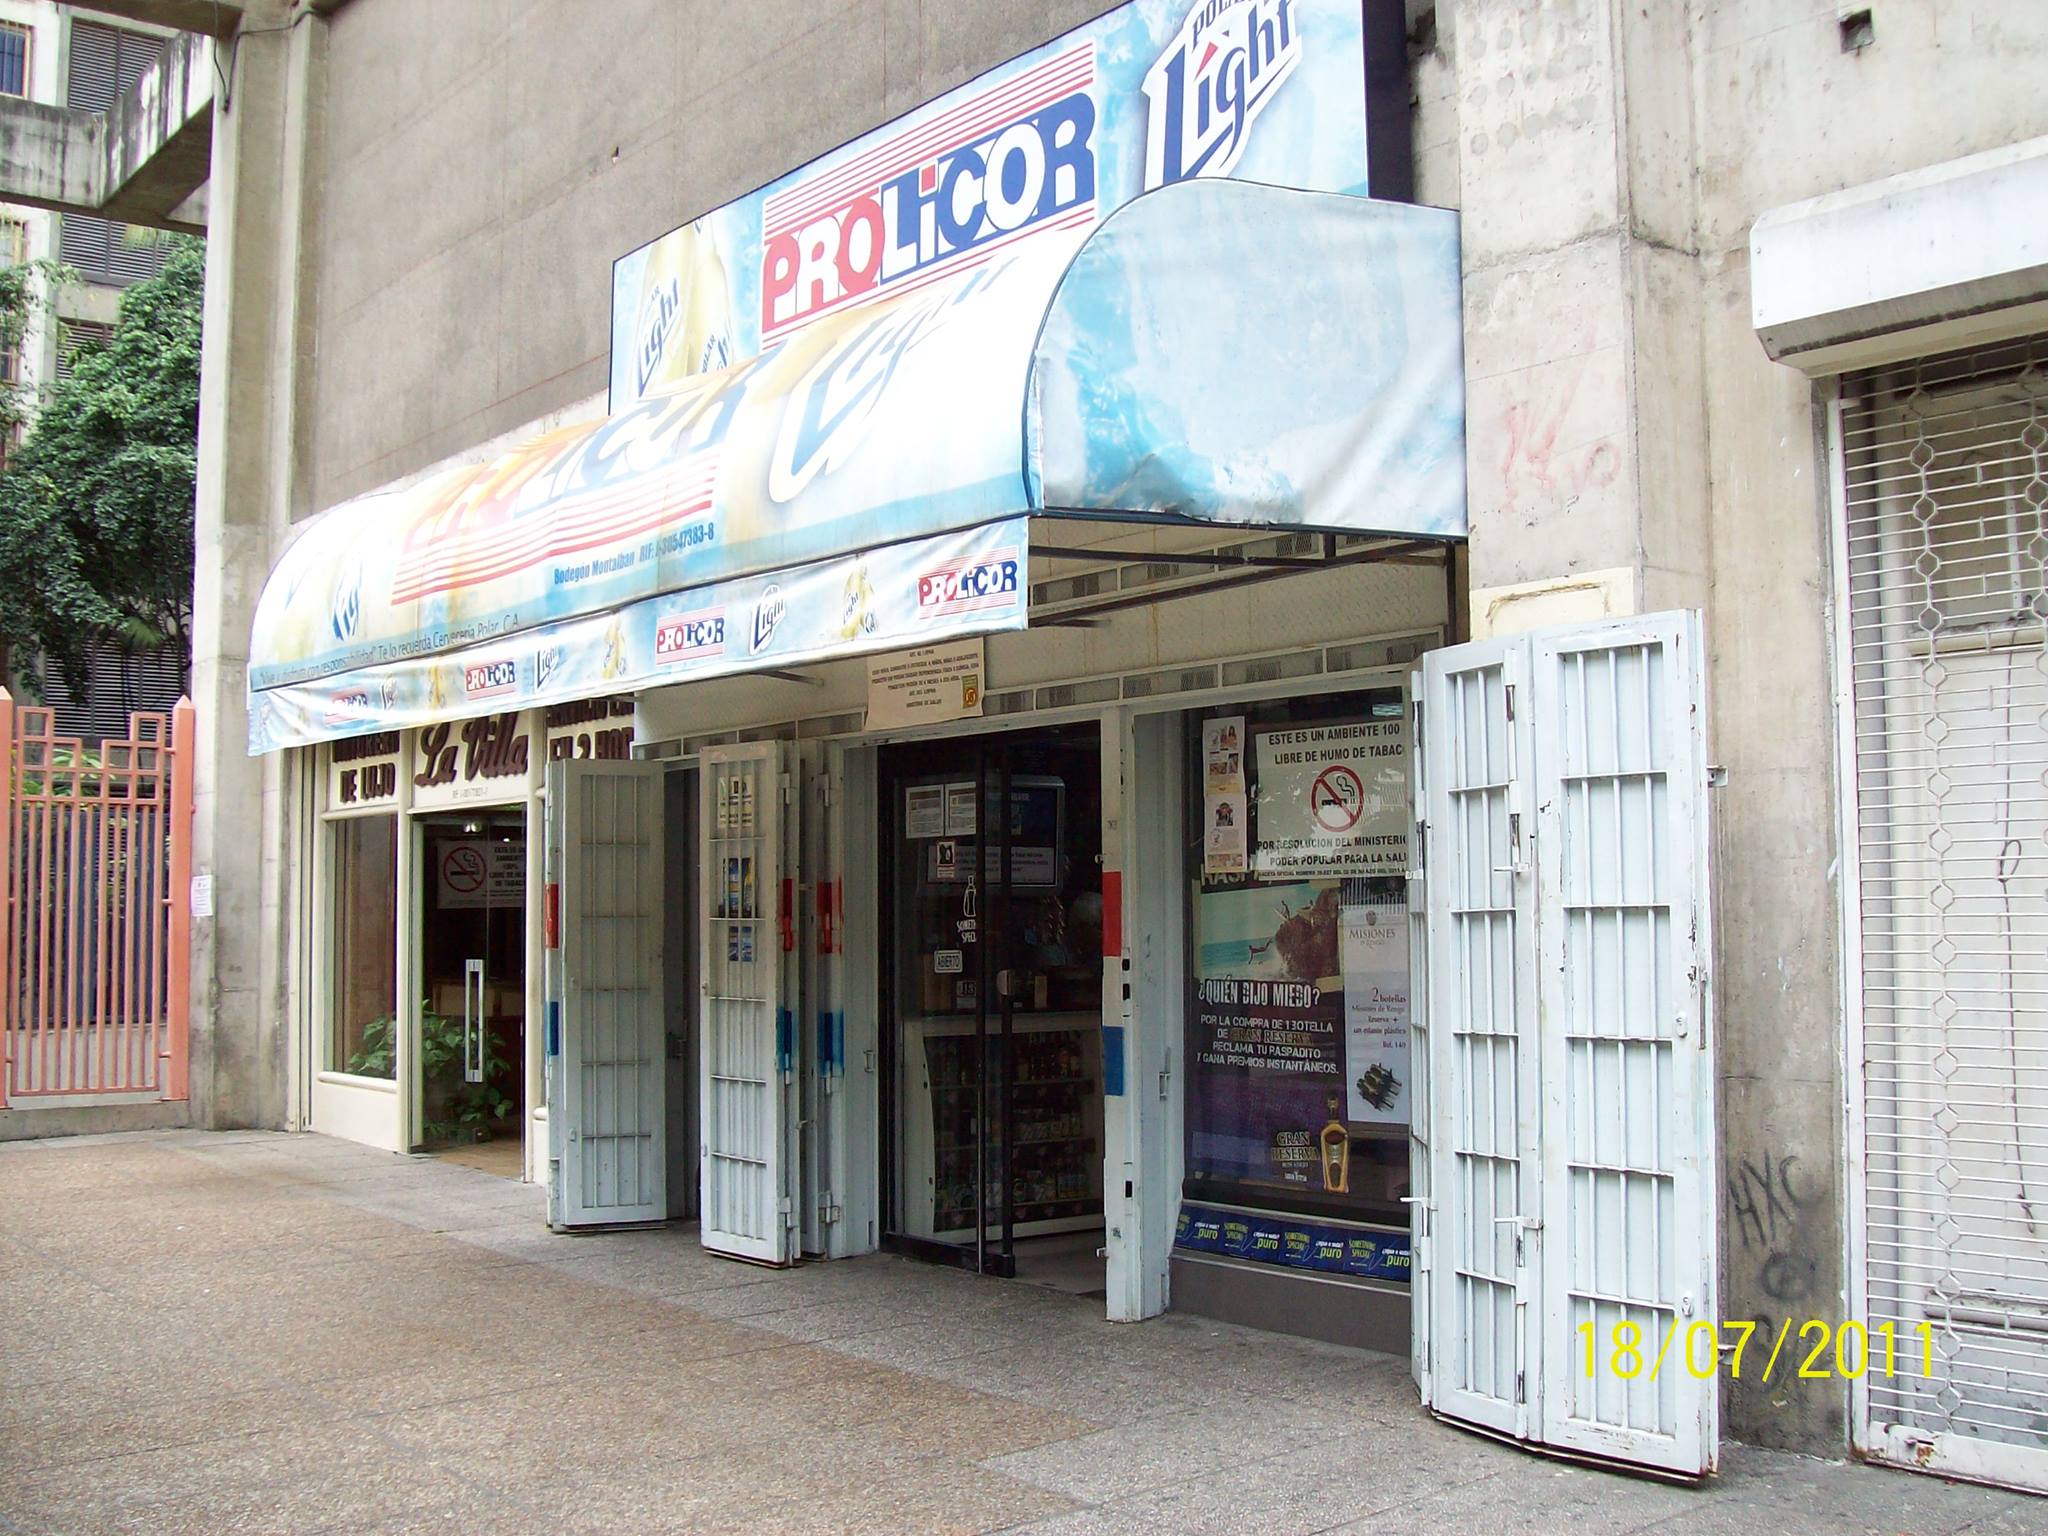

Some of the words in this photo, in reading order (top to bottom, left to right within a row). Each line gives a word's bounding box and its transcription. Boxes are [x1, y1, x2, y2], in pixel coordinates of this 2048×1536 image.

[1192, 0, 1251, 53] POL
[1163, 0, 1295, 185] Light
[763, 92, 1095, 333] PROLICOR
[637, 278, 679, 398] Light
[918, 560, 1017, 607] PROLICOR
[657, 617, 724, 655] PROLICOR
[466, 661, 516, 692] PROLICOR
[1269, 733, 1293, 746] ESTE
[1295, 731, 1308, 743] ES
[1311, 730, 1324, 742] UN
[1327, 725, 1379, 741] AMBIENTE
[1383, 723, 1400, 736] 100
[415, 722, 458, 787] La
[461, 711, 529, 782] Villa
[1275, 752, 1302, 765] LIBRE
[1305, 750, 1318, 762] DE
[1320, 748, 1349, 761] HUMO
[1353, 747, 1366, 758] DE
[1370, 744, 1404, 756] TABAC
[340, 769, 357, 804] DE
[360, 763, 397, 800] LUJO
[1257, 840, 1275, 851] POR
[1335, 836, 1353, 848] DEL
[1270, 856, 1299, 868] PODER
[1301, 854, 1342, 867] POPULAR
[1345, 853, 1369, 865] PARA
[1371, 853, 1384, 864] LA
[1198, 974, 1239, 1006] ¿QUIÉN
[1242, 982, 1268, 1006] DIJO
[1272, 984, 1321, 1009] MIEDO?
[1372, 987, 1379, 1002] 2
[1201, 1014, 1217, 1025] POR
[1219, 1015, 1231, 1026] LA
[1233, 1016, 1269, 1029] COMPRA
[1271, 1018, 1284, 1030] DE
[1217, 1029, 1229, 1039] DE
[1213, 1041, 1254, 1054] RECLAMA
[1257, 1045, 1268, 1054] TU
[1269, 1046, 1321, 1059] RASPADITO
[1203, 1053, 1226, 1065] GANA
[1227, 1055, 1265, 1067] PREMIOS
[1276, 1131, 1311, 1147] GRAN
[1198, 1226, 1219, 1241] puro
[1257, 1237, 1278, 1250] puro
[1320, 1246, 1343, 1260] puro
[1386, 1254, 1410, 1268] puro
